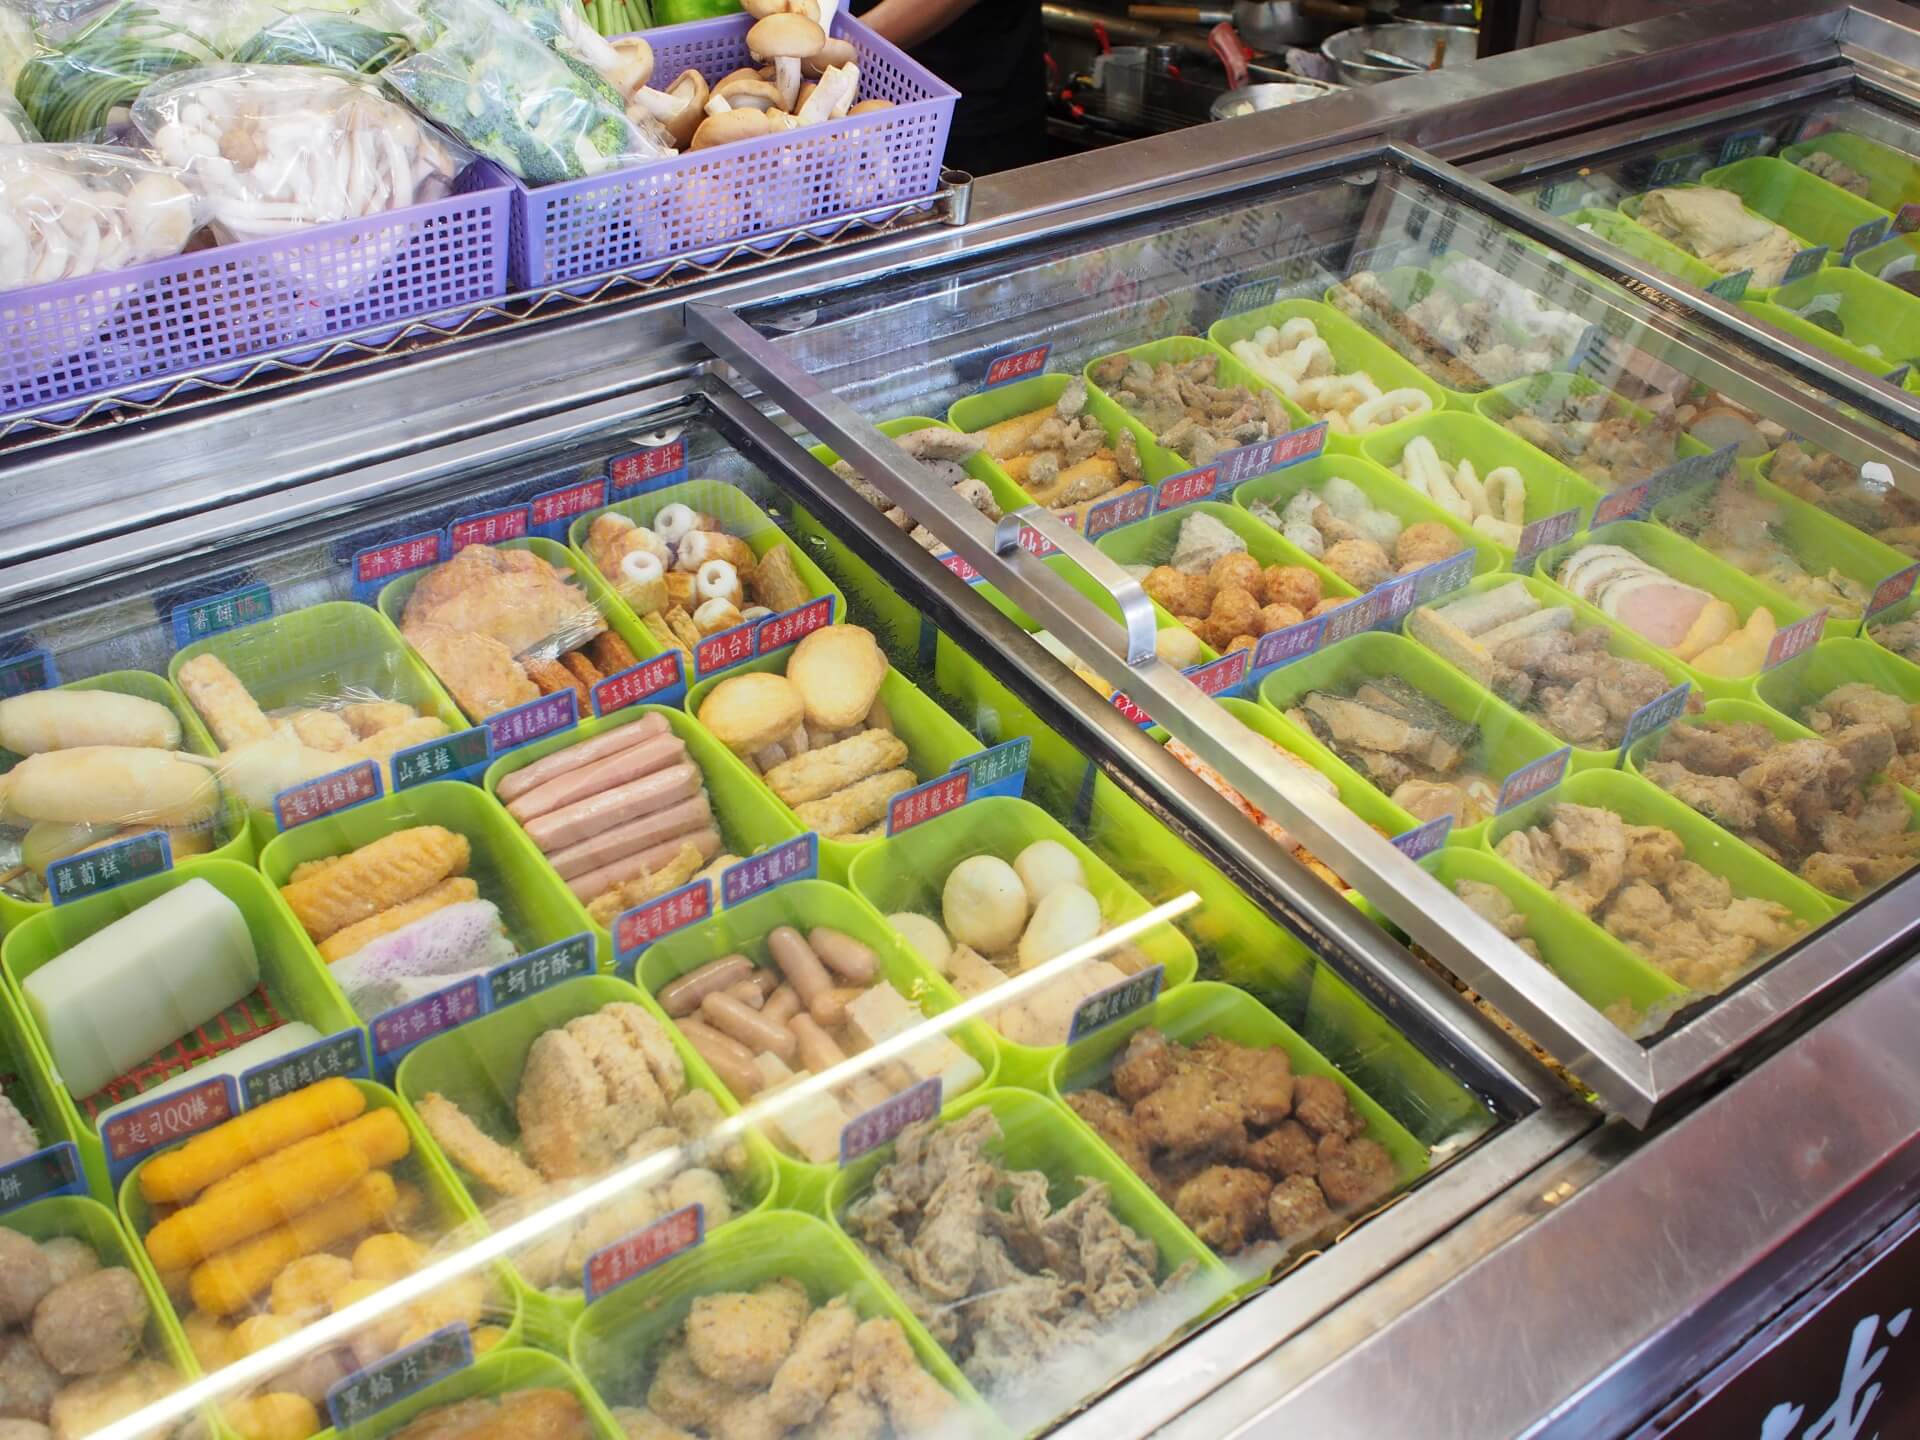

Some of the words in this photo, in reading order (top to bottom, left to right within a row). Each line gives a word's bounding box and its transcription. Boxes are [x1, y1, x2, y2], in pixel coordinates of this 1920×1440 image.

[625, 450, 673, 480] 蔬菜片
[371, 542, 425, 570] 牛蒡排
[612, 666, 665, 704] 玉米豆皮酥
[58, 856, 121, 893] 蘿蔔糕
[634, 894, 694, 938] 起司香腸
[507, 949, 572, 993] 蚵仔酥
[128, 1096, 209, 1146] 起司QQ棒
[342, 1356, 419, 1417] 黑輪片
